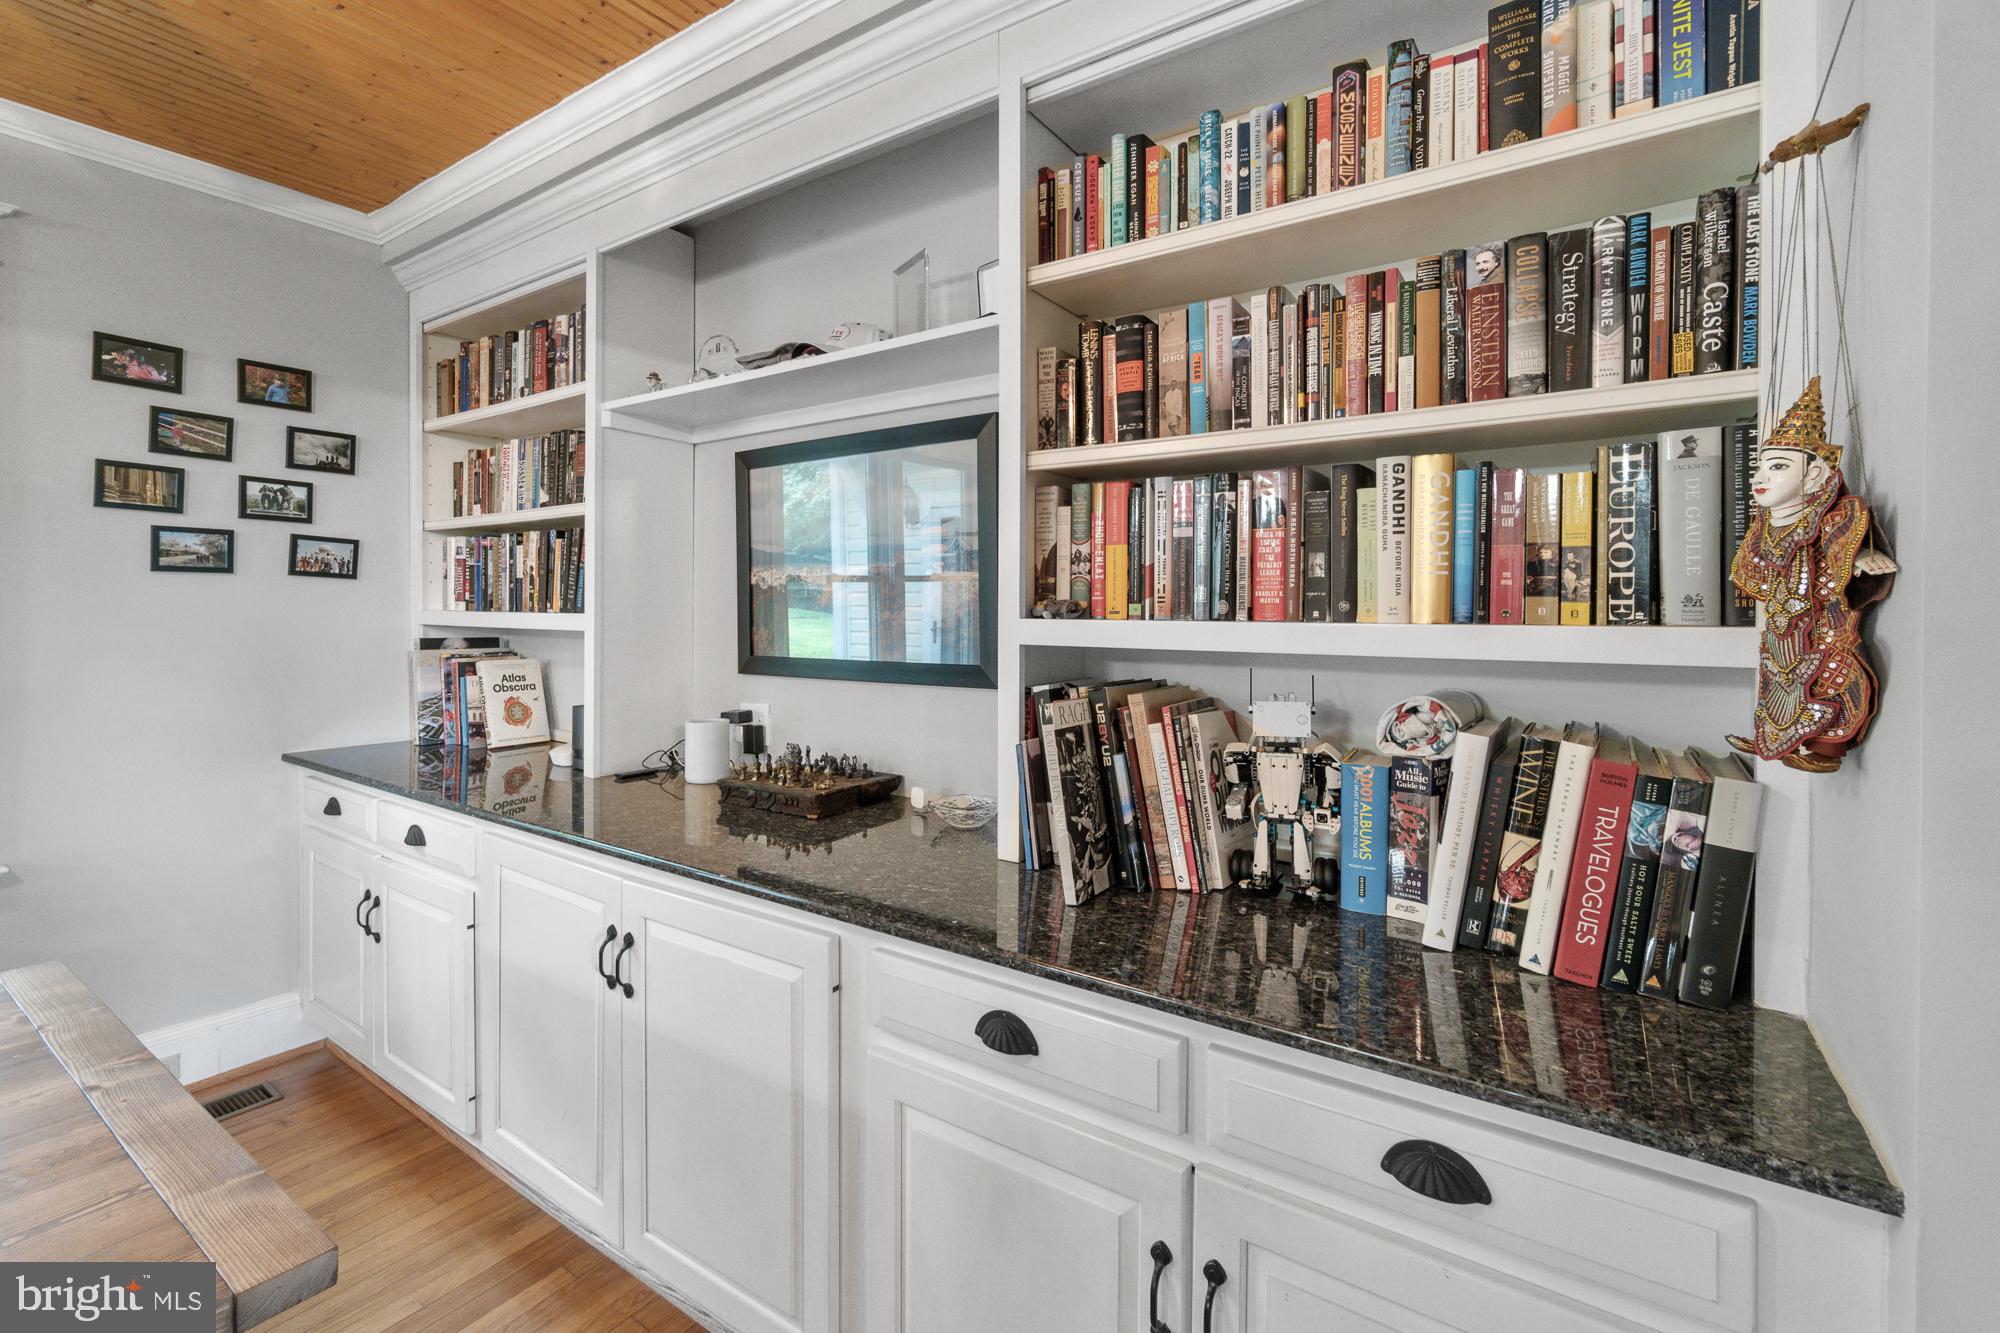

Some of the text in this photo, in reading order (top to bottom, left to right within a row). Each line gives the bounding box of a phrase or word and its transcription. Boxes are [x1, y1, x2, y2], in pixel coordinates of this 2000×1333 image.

[1490, 12, 1537, 33] SHAKESPEARE
[1497, 7, 1530, 23] WILLIAM
[1493, 36, 1535, 56] COMPLETE
[1499, 46, 1529, 62] WORKS
[1506, 31, 1521, 42] THE
[1558, 55, 1570, 96] MAGGIE
[1672, 41, 1692, 79] JEST
[1433, 72, 1443, 118] RUSHDIE
[1543, 50, 1555, 109] SHIPSTEAD
[1414, 89, 1425, 132] Georges Perec
[1224, 127, 1233, 204] CATCH-22 JOSEPH
[1415, 145, 1423, 170] VOID
[1074, 162, 1082, 202] CENSUS
[1254, 166, 1262, 189] PETER
[1629, 215, 1648, 288] MARK BOWDEN
[1654, 239, 1666, 251] THE
[1680, 225, 1693, 284] COMPLEXITY
[1703, 210, 1717, 268] Wilkerson
[1716, 219, 1730, 254] Isabel
[1601, 237, 1614, 275] ARMY
[1654, 251, 1666, 285] GEOGRAPHY
[1515, 245, 1540, 320] COLLAPSE
[1555, 252, 1584, 336] Strategy
[1654, 285, 1665, 293] OF
[1741, 193, 1760, 364] THE LAST STONE MARK BOWDEN
[1403, 292, 1411, 323] BENJAMIN
[1446, 287, 1459, 325] Liberal
[1654, 293, 1665, 322] NOWHERE
[1701, 281, 1729, 352] Caste
[1081, 331, 1090, 358] TOMB
[1089, 328, 1099, 359] LENIN'S
[1335, 313, 1343, 369] ESSENCE OF DECISION
[1368, 311, 1382, 376] THINKING IN TIME
[1402, 333, 1411, 355] BARBER
[1446, 326, 1459, 380] Leviathan
[1472, 294, 1482, 389] WALTER ISAACSON
[1481, 291, 1500, 386] EINSTEIN
[1630, 292, 1646, 379] WORM
[1674, 334, 1683, 354] SAVES
[1683, 334, 1692, 352] USED
[1673, 461, 1711, 473] JACKSON
[1732, 430, 1745, 537] THE MULTIPLE LIVES OF FRANÇOIS
[1339, 485, 1347, 500] King
[1391, 462, 1406, 535] GANDHI
[1501, 504, 1515, 515] GREAT
[1504, 491, 1513, 502] THE
[1416, 473, 1426, 576] RAMACHANDRA GUHA
[1429, 471, 1450, 576] GANDHI
[1480, 493, 1488, 534] MULTILATERALISM
[1502, 517, 1515, 527] GAME
[1685, 477, 1702, 577] DE GAULLE
[1289, 538, 1297, 562] NORTH
[1607, 445, 1646, 621] EUROPE
[1257, 561, 1283, 569] FATHERLY
[1289, 564, 1297, 588] KOREA
[1238, 583, 1246, 611] INFLUENCE
[1394, 573, 1402, 597] INDIA
[492, 682, 537, 693] Obscura
[501, 673, 527, 683] Atlas
[1194, 742, 1202, 763] ONION
[1406, 766, 1419, 775] All
[1163, 711, 1191, 844] THE COMMISSAR VANISHES DAVID KING
[1200, 785, 1208, 805] DUMB
[1394, 770, 1429, 785] Music
[1396, 780, 1417, 789] Guide
[1510, 748, 1544, 825] WINE
[1534, 750, 1556, 827] THE SOTHEBY'S
[1599, 778, 1628, 789] HOLMES
[1601, 772, 1629, 783] BURTON
[1156, 751, 1183, 859] MUGHAL EMPERORS
[1203, 806, 1212, 831] WORLD
[1359, 771, 1374, 861] 1001 ALBUMS
[1487, 776, 1501, 828] WHISKY
[1551, 754, 1578, 864] THE FRENCH LAUNDRY
[1725, 790, 1741, 846] GRANT ACHATZ
[1391, 792, 1429, 867] Jazz
[1479, 840, 1491, 882] JAPAN
[1575, 805, 1620, 946] TRAVELOGUES
[1664, 871, 1677, 908] MANGOES
[1711, 875, 1728, 927] ALINEA
[1623, 864, 1648, 965] HOT SOUR SALTY SWEET
[1657, 915, 1670, 943] CURRY
[1494, 930, 1515, 943] DK
[1564, 967, 1593, 981] TASCHEN
[1653, 943, 1666, 971] LEAVES
